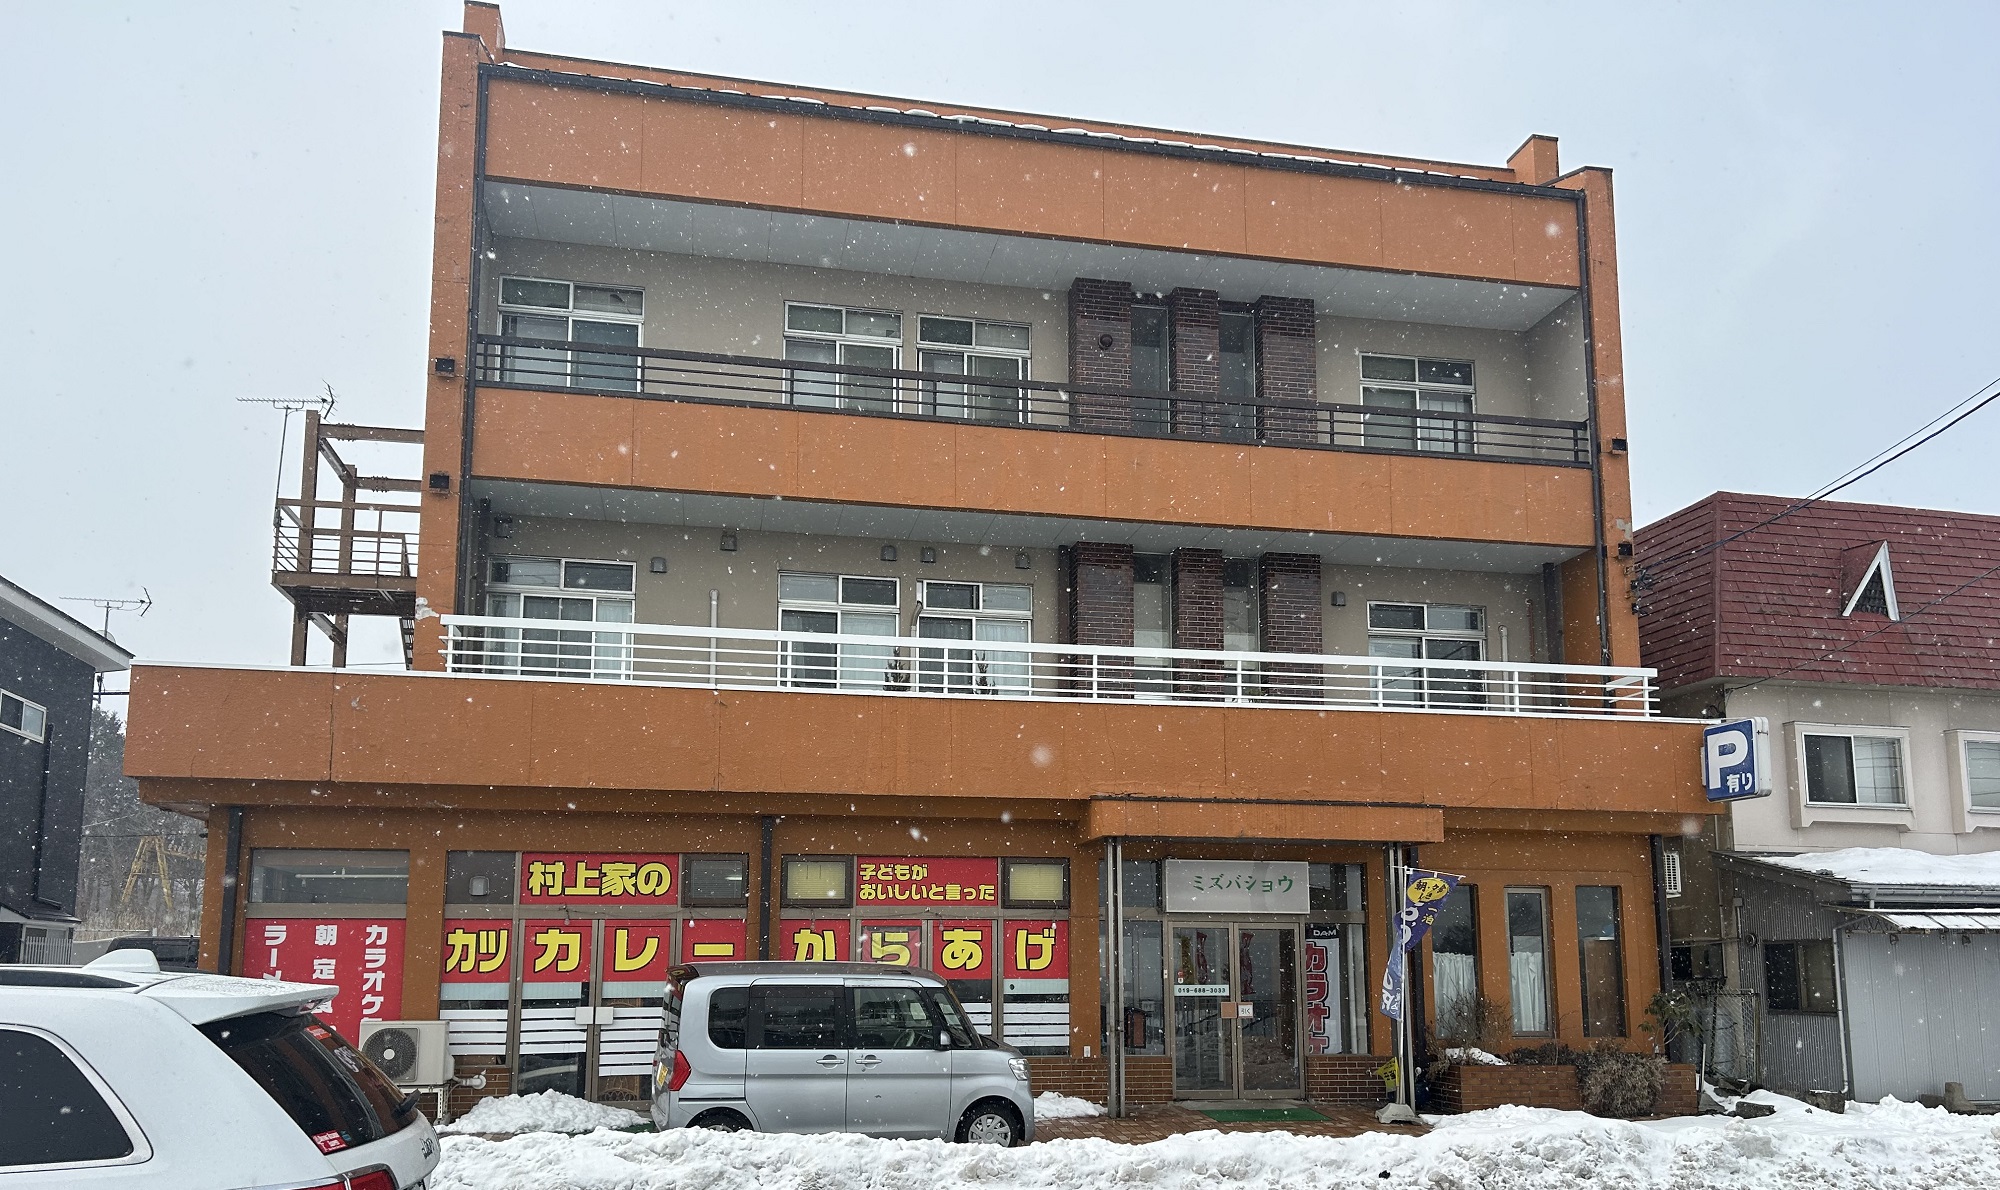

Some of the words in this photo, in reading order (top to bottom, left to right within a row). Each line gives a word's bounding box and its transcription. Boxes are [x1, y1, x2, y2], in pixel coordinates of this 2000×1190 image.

[1707, 730, 1748, 789] P
[1726, 772, 1753, 793] 有り
[528, 861, 672, 896] 村上家の
[860, 863, 928, 881] 子どもが
[859, 883, 995, 900] おいしいと言った
[1192, 873, 1294, 893] ミズバショウ
[1313, 929, 1337, 937] DAM
[361, 924, 388, 1022] カラオケ
